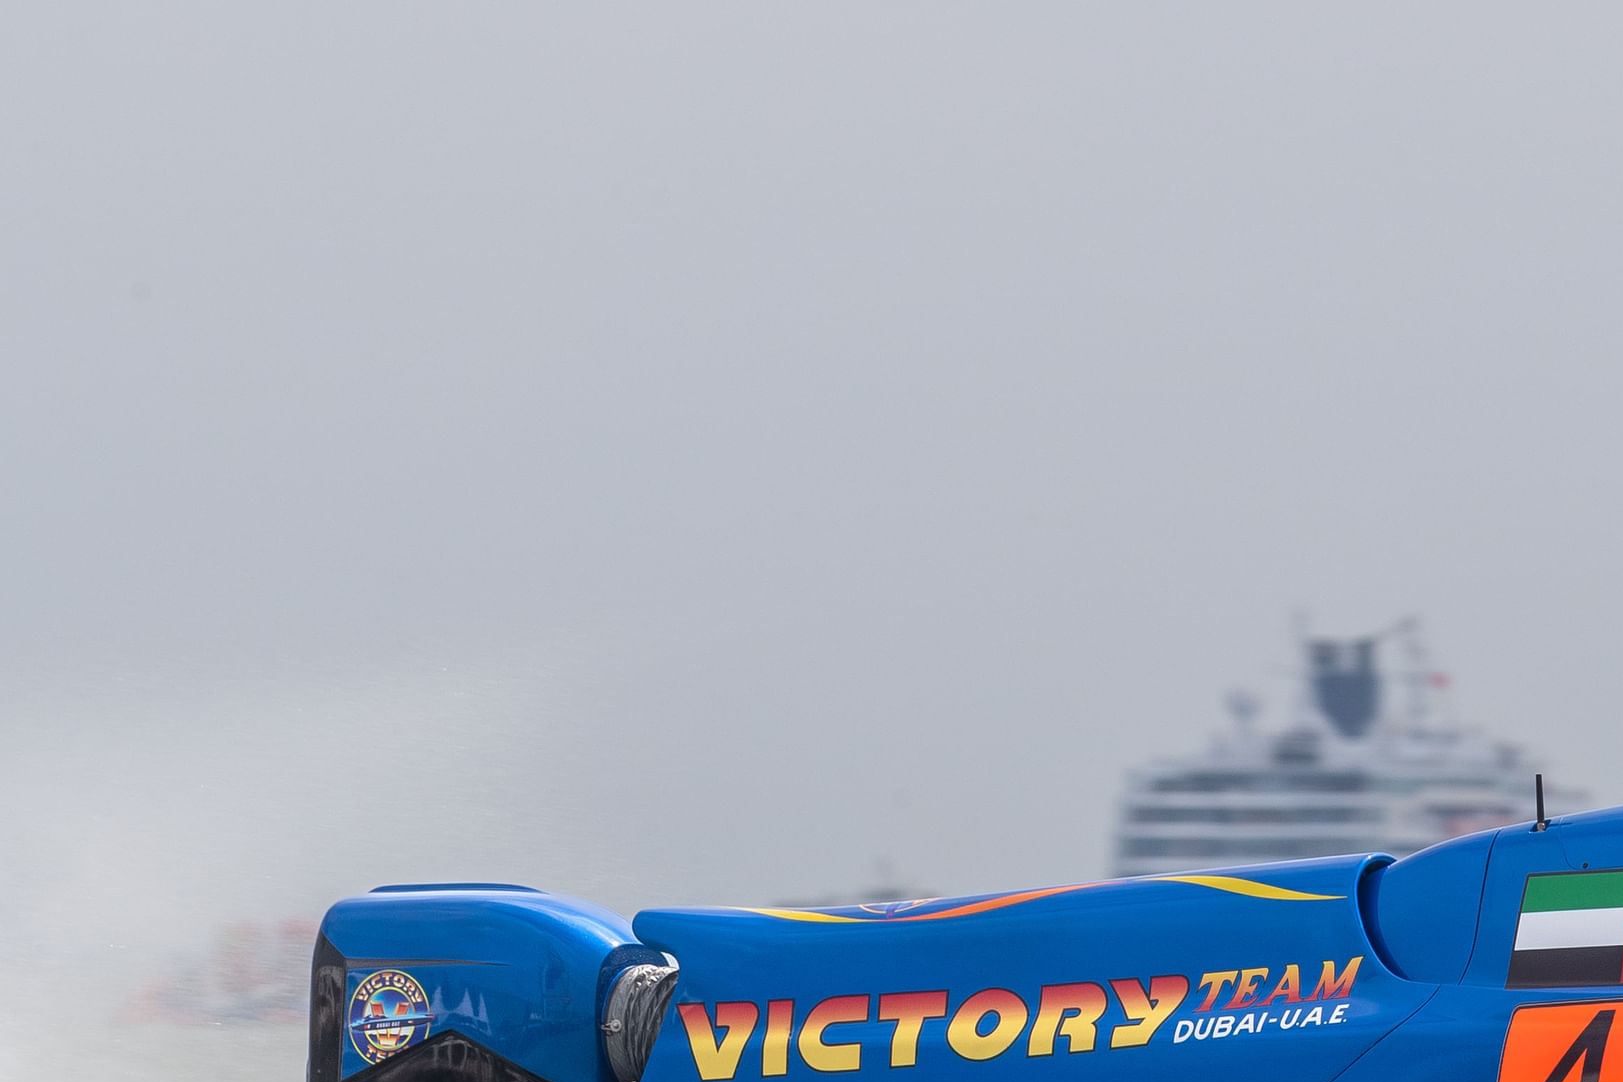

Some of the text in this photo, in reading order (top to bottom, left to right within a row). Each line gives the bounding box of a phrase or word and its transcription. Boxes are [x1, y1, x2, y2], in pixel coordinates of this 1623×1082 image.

[356, 973, 423, 1003] VICTORY
[1194, 955, 1364, 1015] TEAM
[678, 976, 1189, 1082] VICTORY
[1173, 1003, 1350, 1044] DUBAI-U.A.E.
